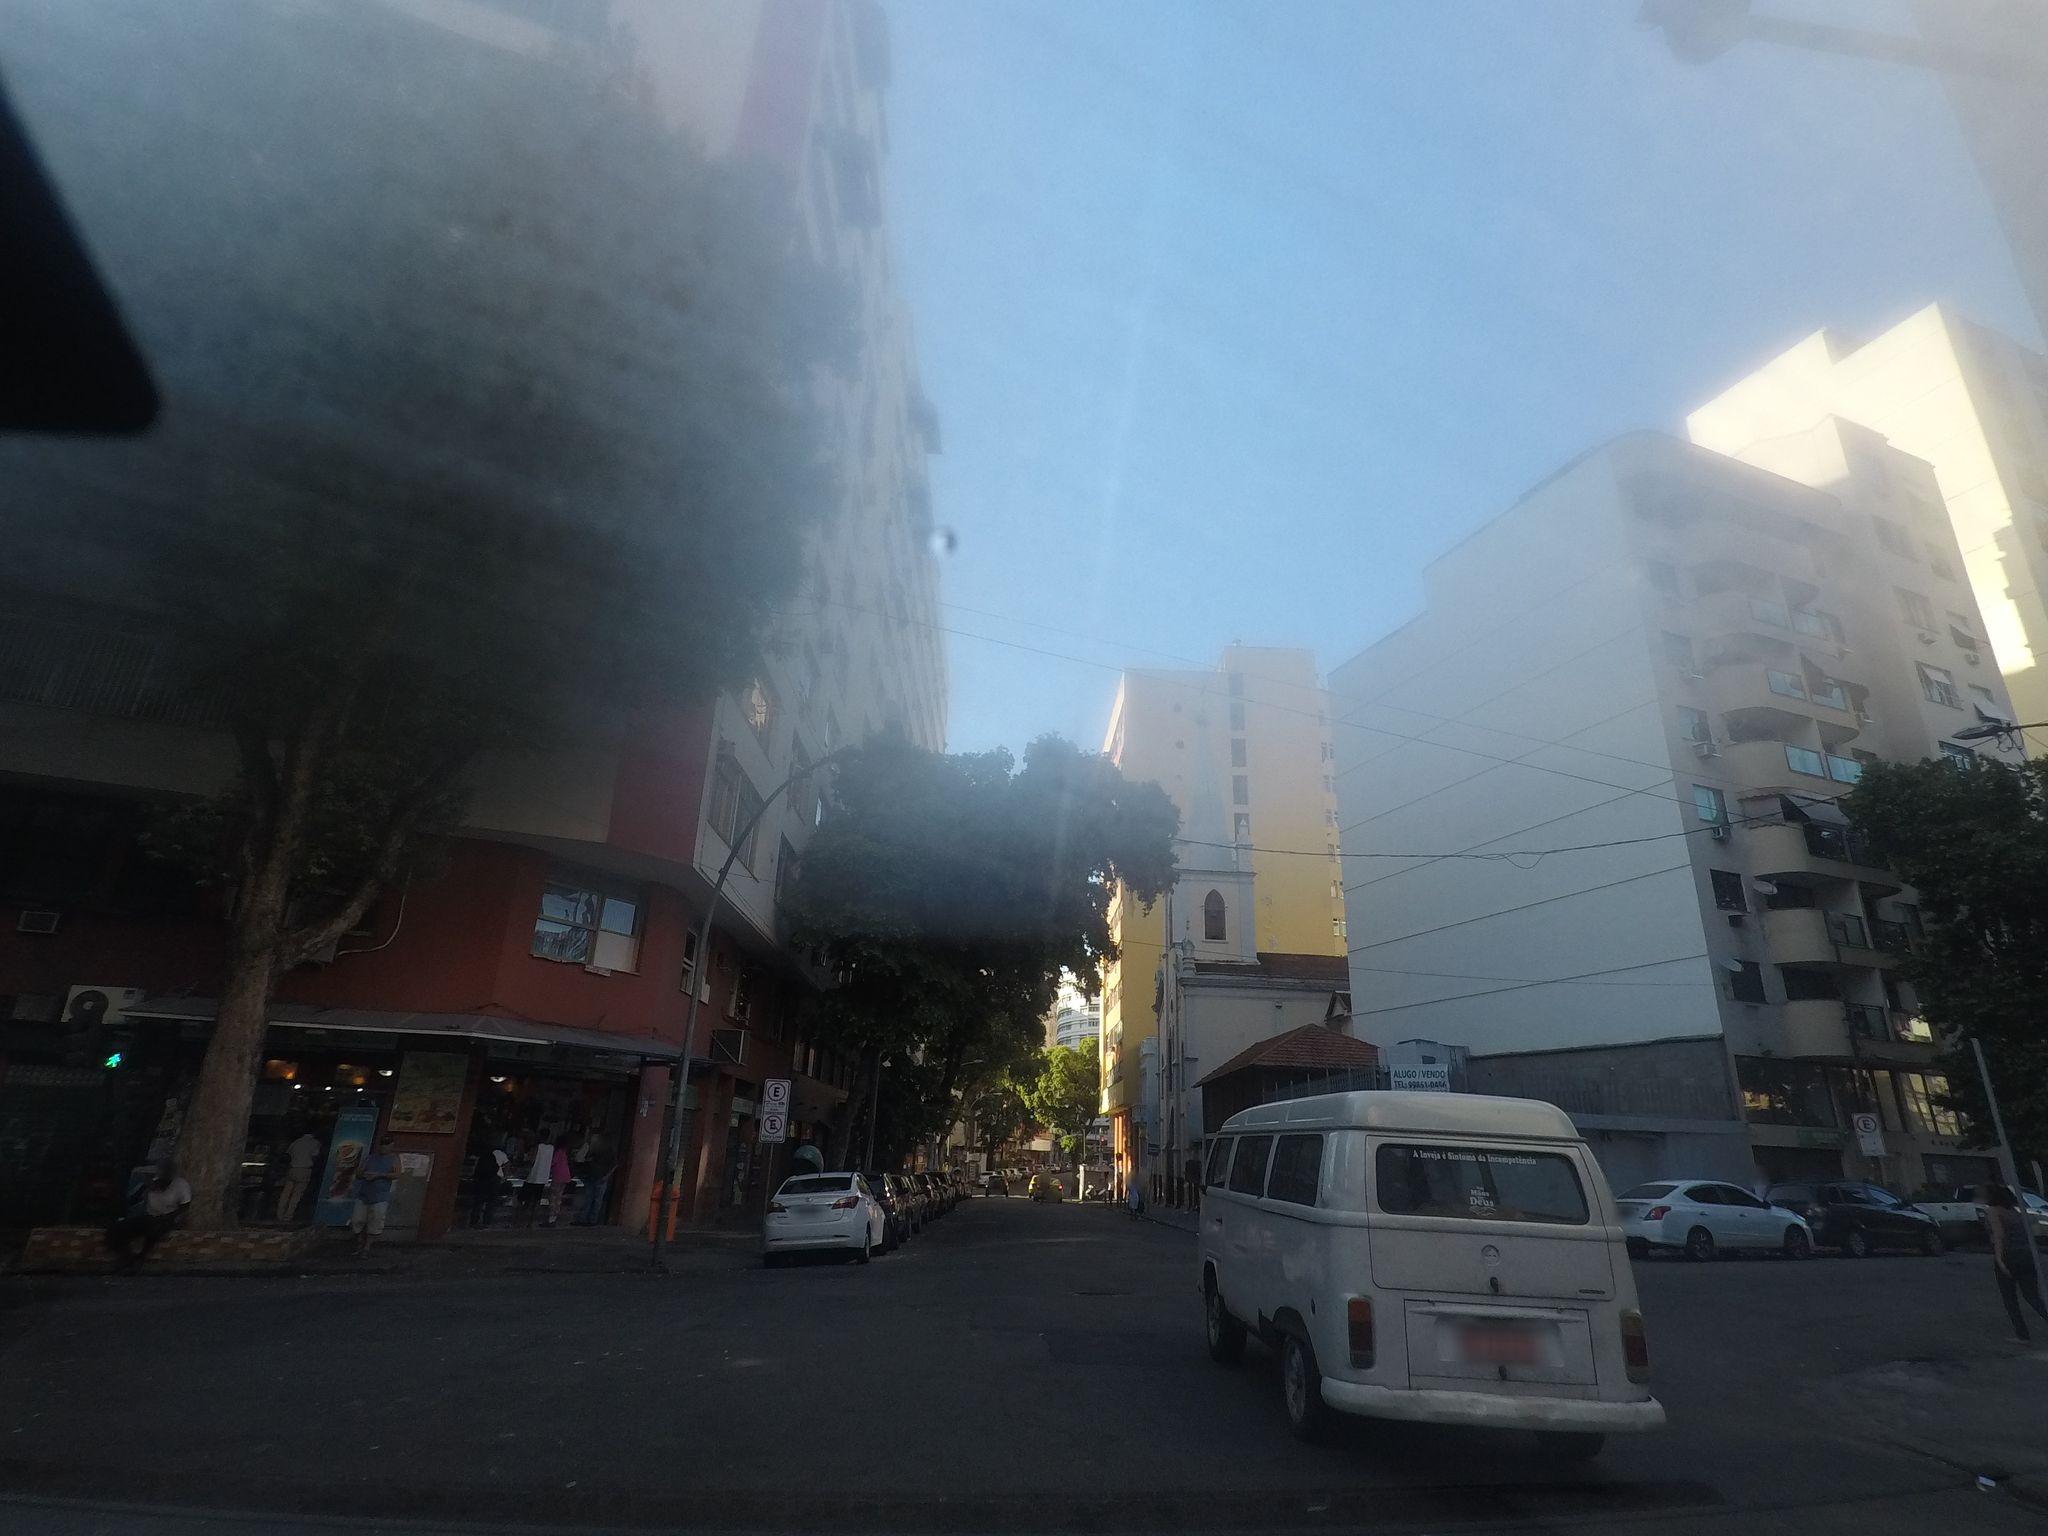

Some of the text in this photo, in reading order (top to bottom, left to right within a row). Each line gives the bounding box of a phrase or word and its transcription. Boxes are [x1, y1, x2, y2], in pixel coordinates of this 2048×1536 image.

[1393, 1070, 1417, 1079] ALUGO
[1421, 1070, 1446, 1079] VENDO
[1394, 1080, 1408, 1089] TEL:
[773, 1087, 780, 1097] E
[1862, 1119, 1872, 1130] E
[1412, 1149, 1419, 1158] A
[1447, 1151, 1477, 1162] Sintoma
[1477, 1153, 1487, 1162] da
[1469, 1196, 1495, 1207] Deus
